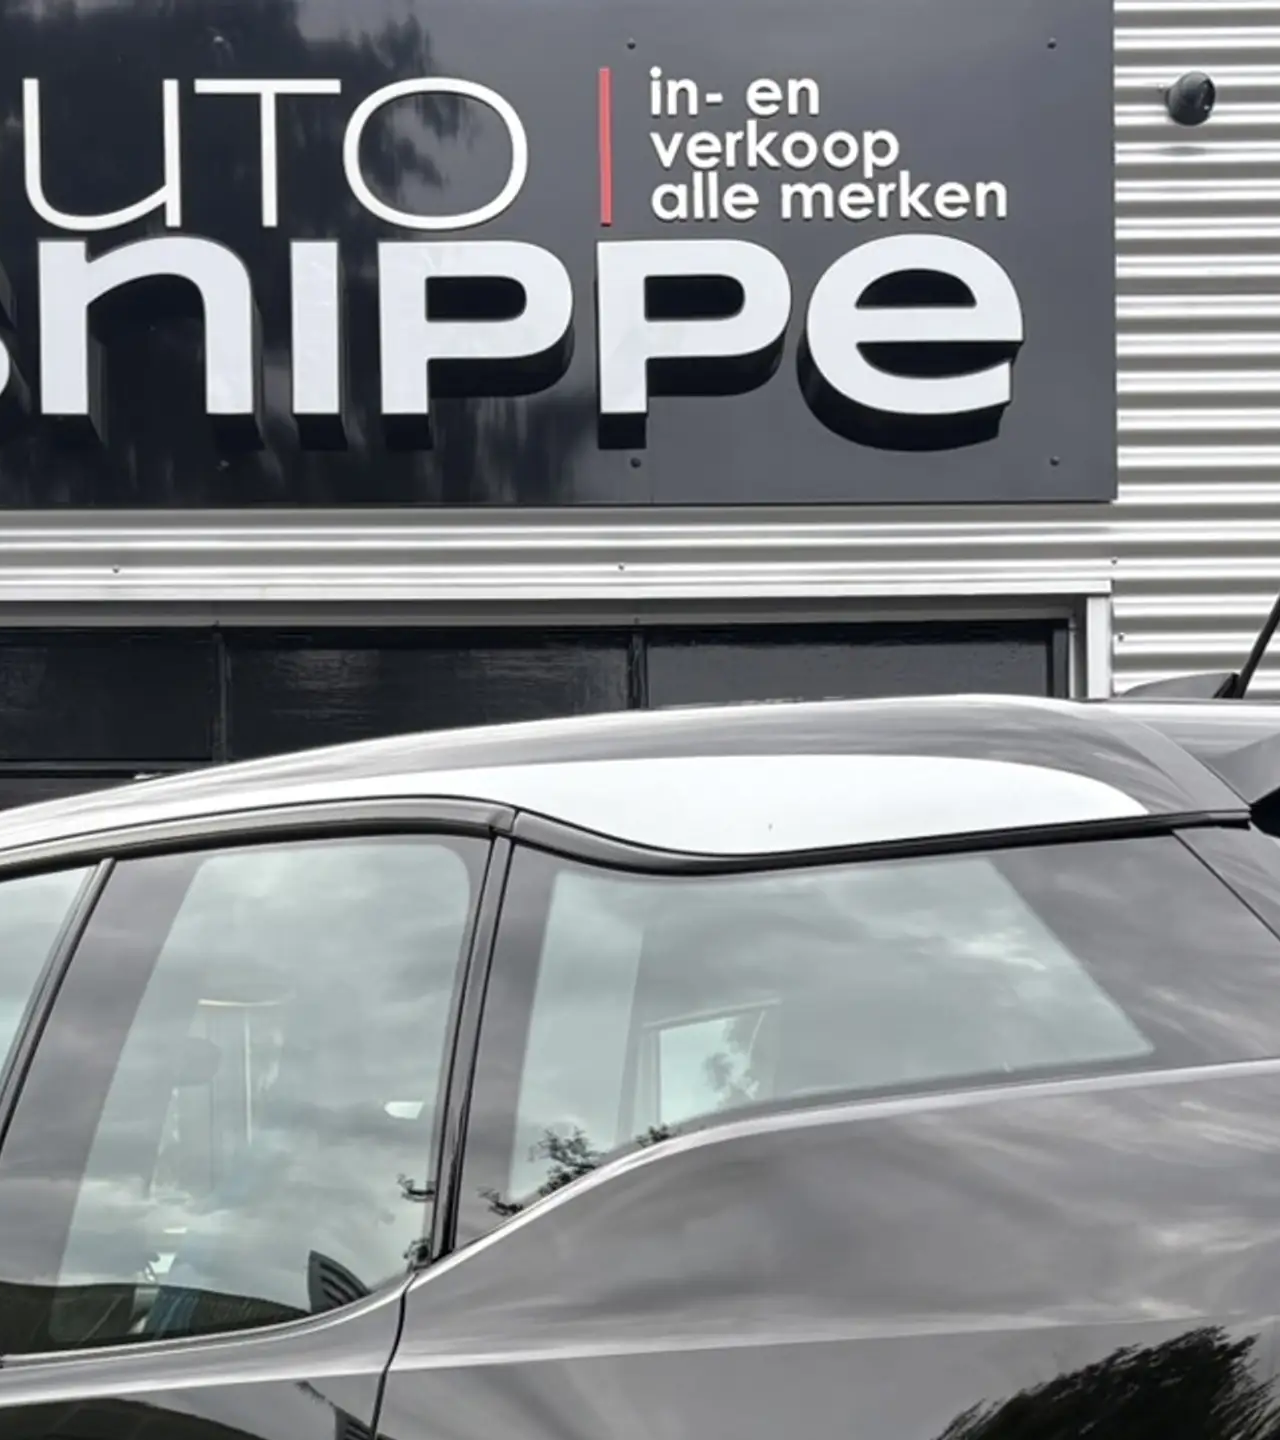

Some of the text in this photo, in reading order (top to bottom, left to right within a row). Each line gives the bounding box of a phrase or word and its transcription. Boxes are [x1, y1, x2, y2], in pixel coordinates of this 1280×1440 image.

[649, 66, 820, 116] in- en
[649, 118, 900, 179] verkoop
[651, 169, 1008, 220] alle merken
